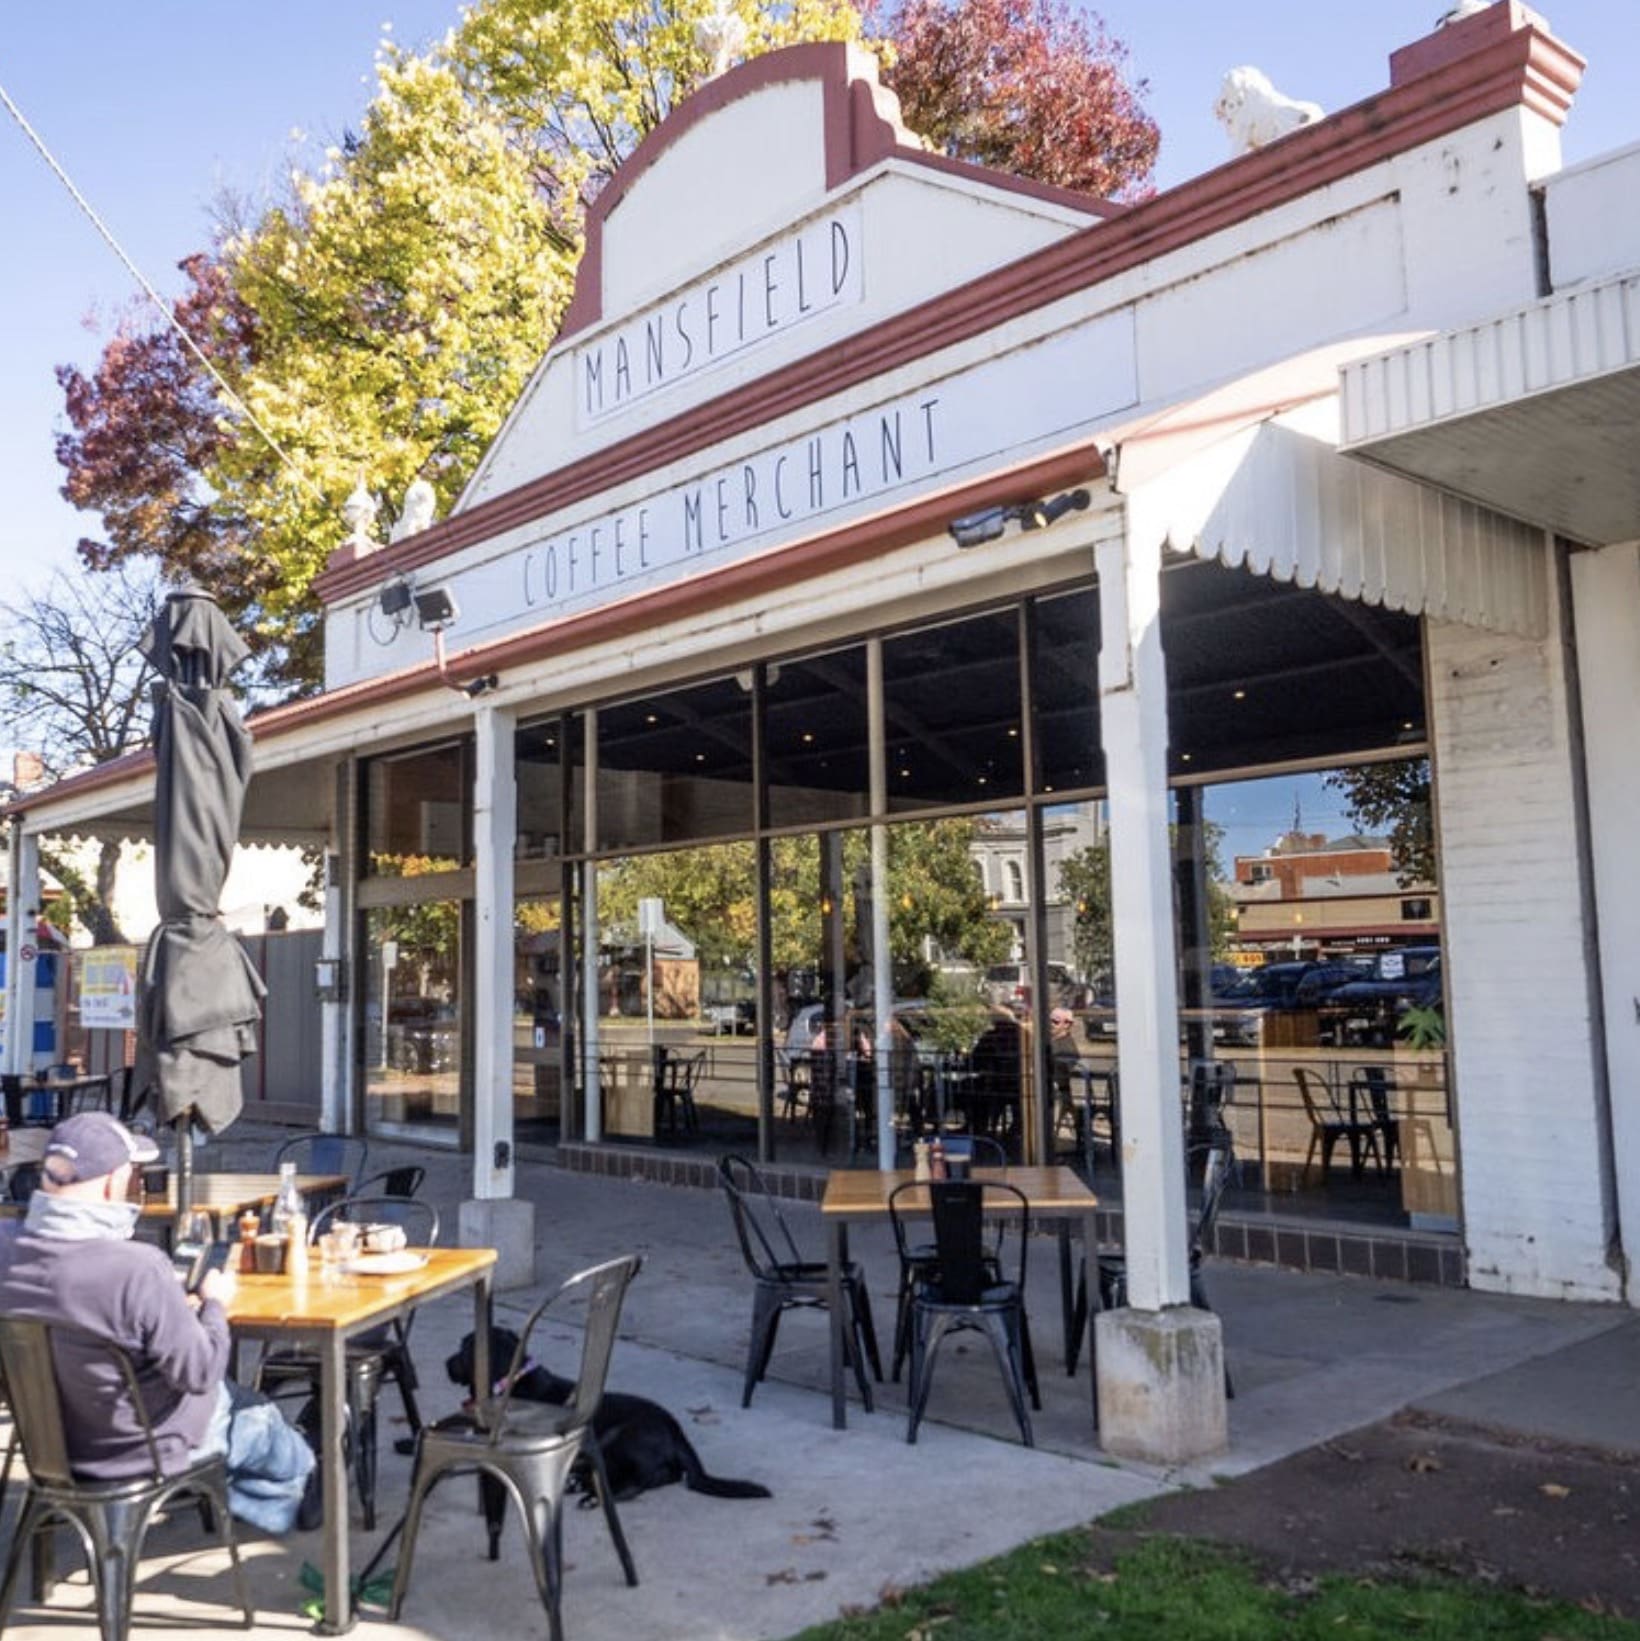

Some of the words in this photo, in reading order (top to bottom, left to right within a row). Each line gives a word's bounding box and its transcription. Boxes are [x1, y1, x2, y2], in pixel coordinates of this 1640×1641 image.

[585, 220, 849, 414] MANSFIELD
[523, 509, 650, 607] COFFEE
[684, 400, 938, 552] MERCHANT
